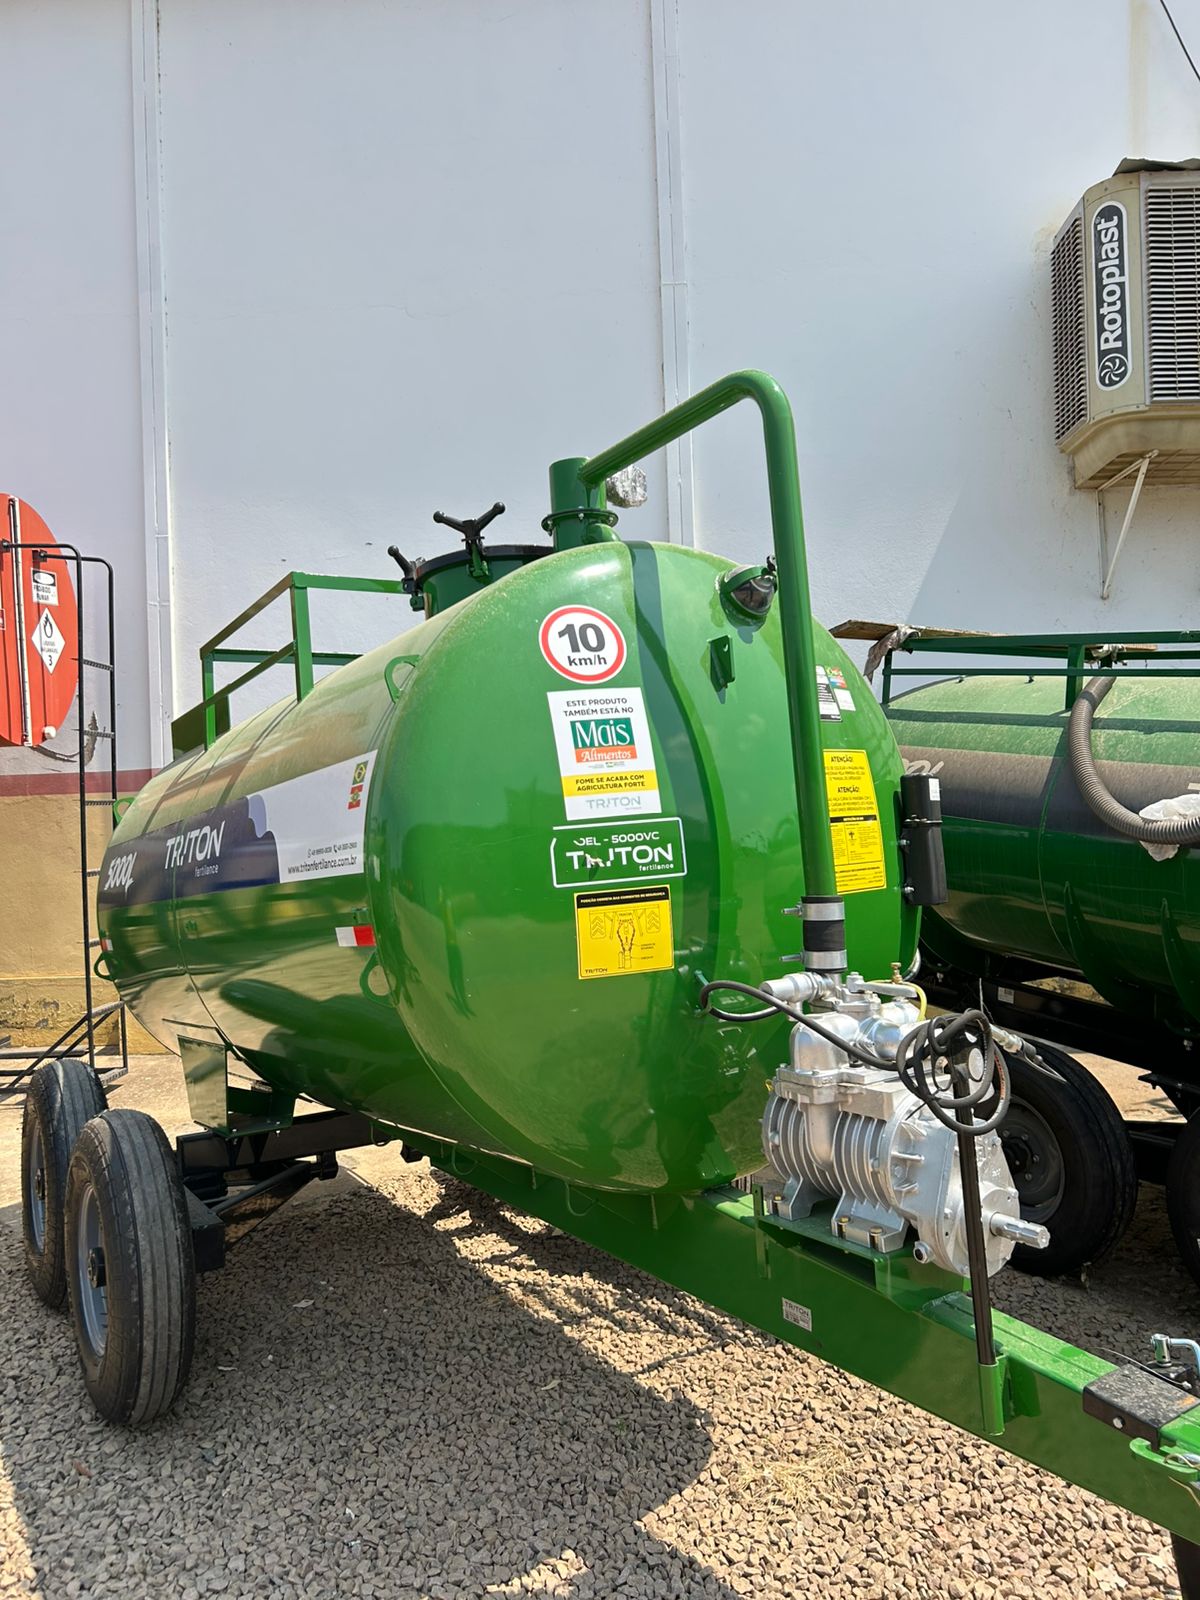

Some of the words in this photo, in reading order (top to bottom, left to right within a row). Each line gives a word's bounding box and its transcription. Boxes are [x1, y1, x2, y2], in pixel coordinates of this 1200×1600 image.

[1097, 215, 1125, 350] Rotoplast
[558, 623, 605, 653] 10
[48, 654, 53, 666] 3
[567, 654, 607, 667] km/h
[566, 699, 587, 707] ESTE
[588, 697, 628, 706] PRODUTO
[563, 706, 599, 717] TAMBÉM
[599, 705, 620, 715] ESTÁ
[621, 706, 634, 714] NO
[575, 720, 630, 748] Mais
[580, 748, 632, 762] Alimentos
[576, 783, 623, 792] AGRICULTURA
[585, 795, 641, 809] TRITON
[611, 831, 660, 844] 5000VC
[164, 820, 225, 870] TRITON
[194, 864, 219, 877] fertilance
[287, 854, 357, 874] www.tritonfertilance.com.br
[103, 850, 138, 893] 5000L
